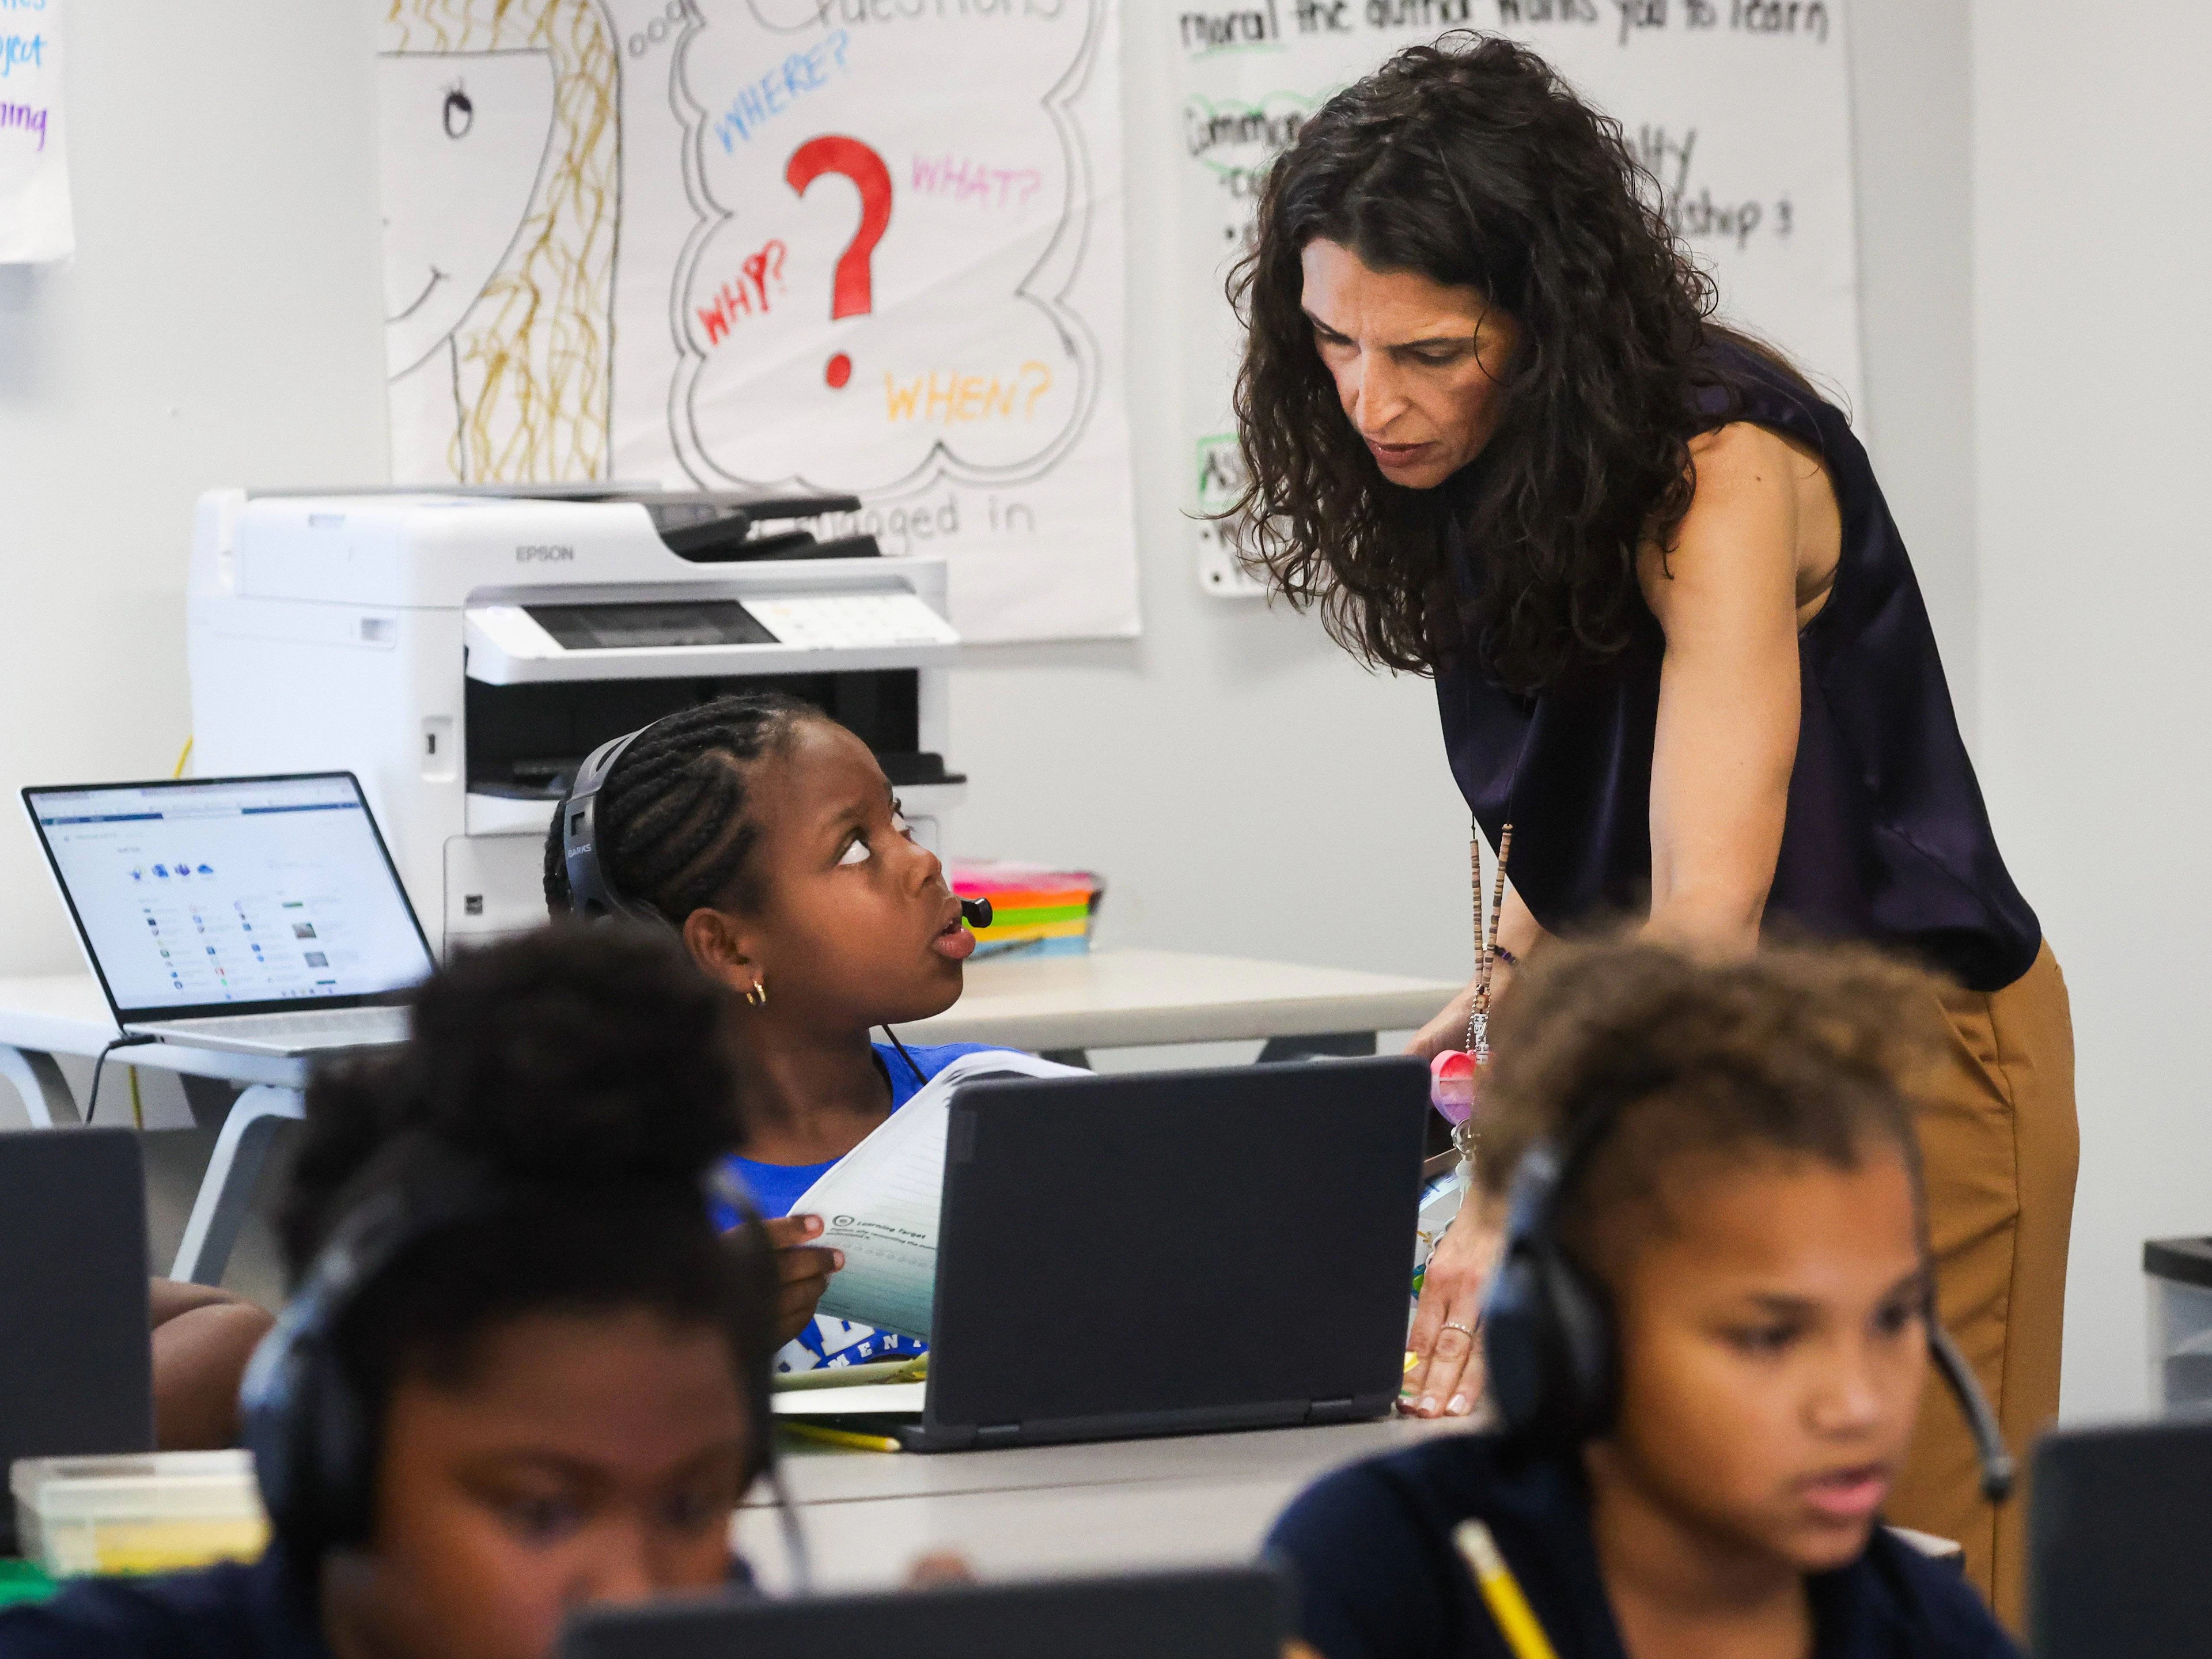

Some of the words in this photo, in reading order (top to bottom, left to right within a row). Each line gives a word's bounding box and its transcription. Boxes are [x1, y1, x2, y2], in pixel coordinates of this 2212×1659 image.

[1180, 0, 1278, 47] moral
[0, 33, 48, 77] ject
[714, 28, 850, 154] WHERE?
[912, 152, 1041, 209] WHAT?
[697, 239, 787, 346] WHY?
[883, 359, 1053, 426] WHEN?
[988, 495, 1035, 531] in
[516, 546, 573, 562] EPSON
